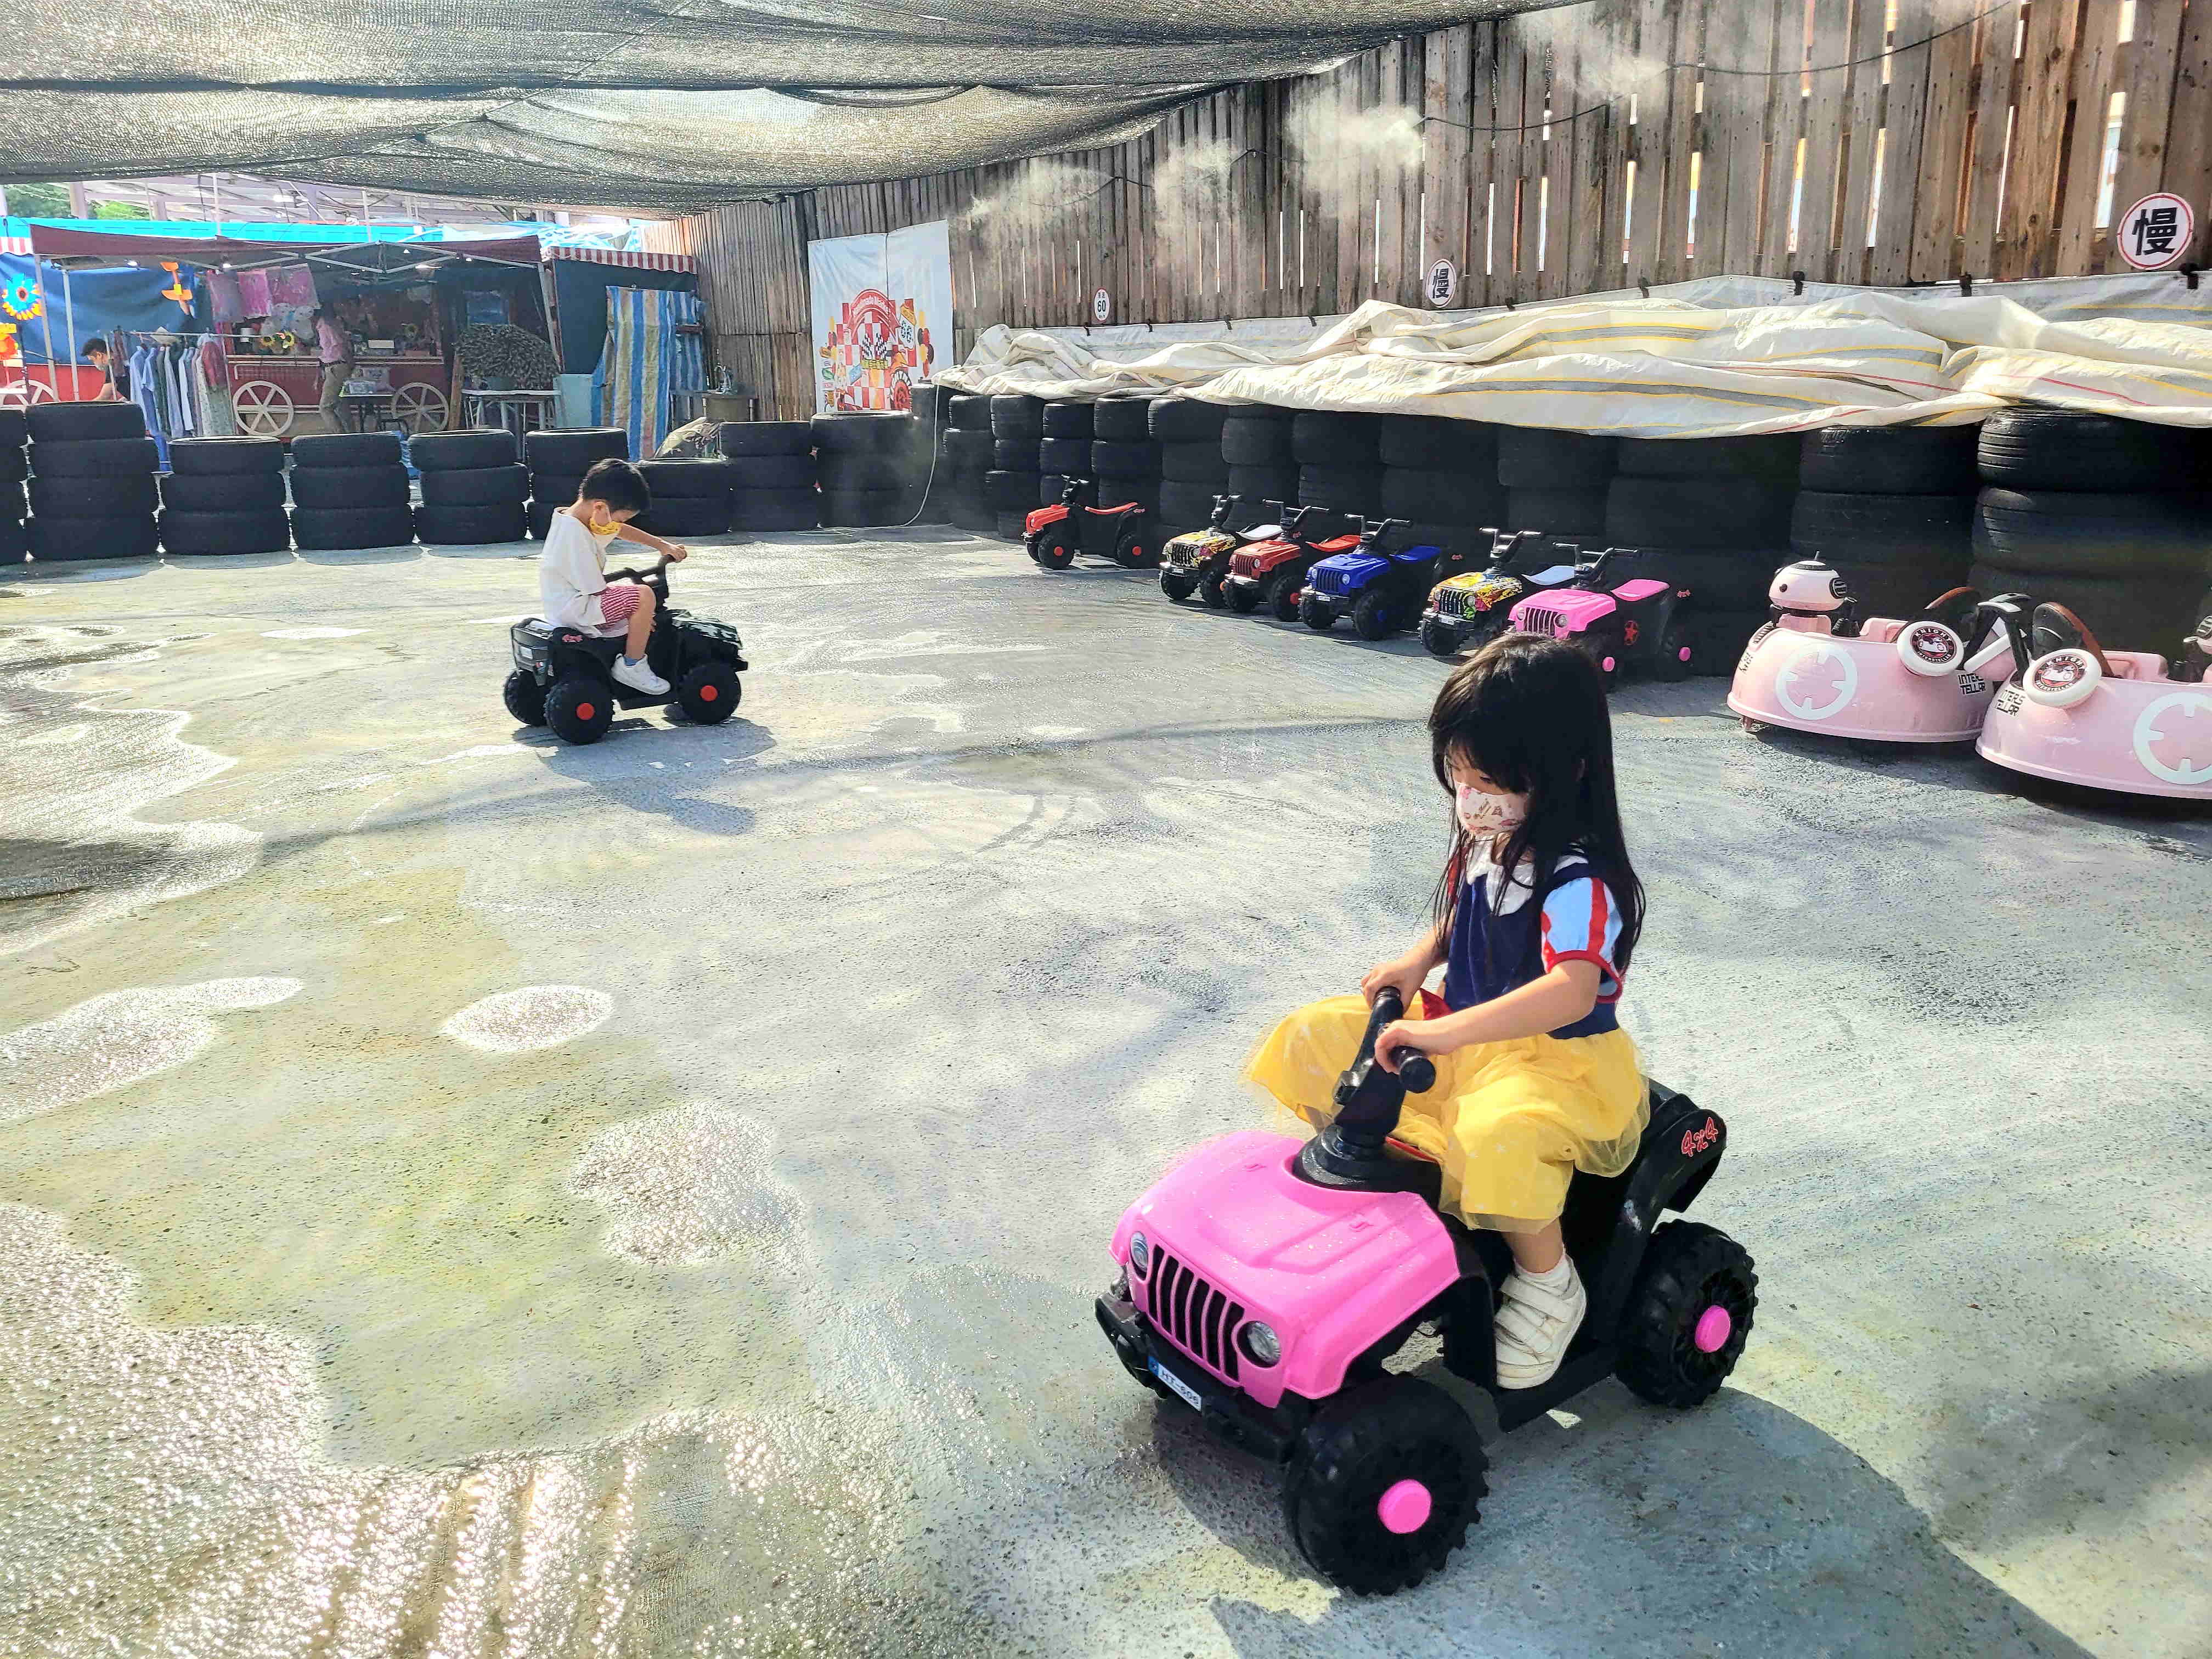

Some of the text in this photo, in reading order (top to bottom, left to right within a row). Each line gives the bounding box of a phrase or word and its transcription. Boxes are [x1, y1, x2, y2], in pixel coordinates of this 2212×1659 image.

[2132, 207, 2177, 256] 慢
[1432, 268, 1449, 298] 慢
[1097, 300, 1106, 312] 60
[1914, 628, 1951, 641] KNIGHT
